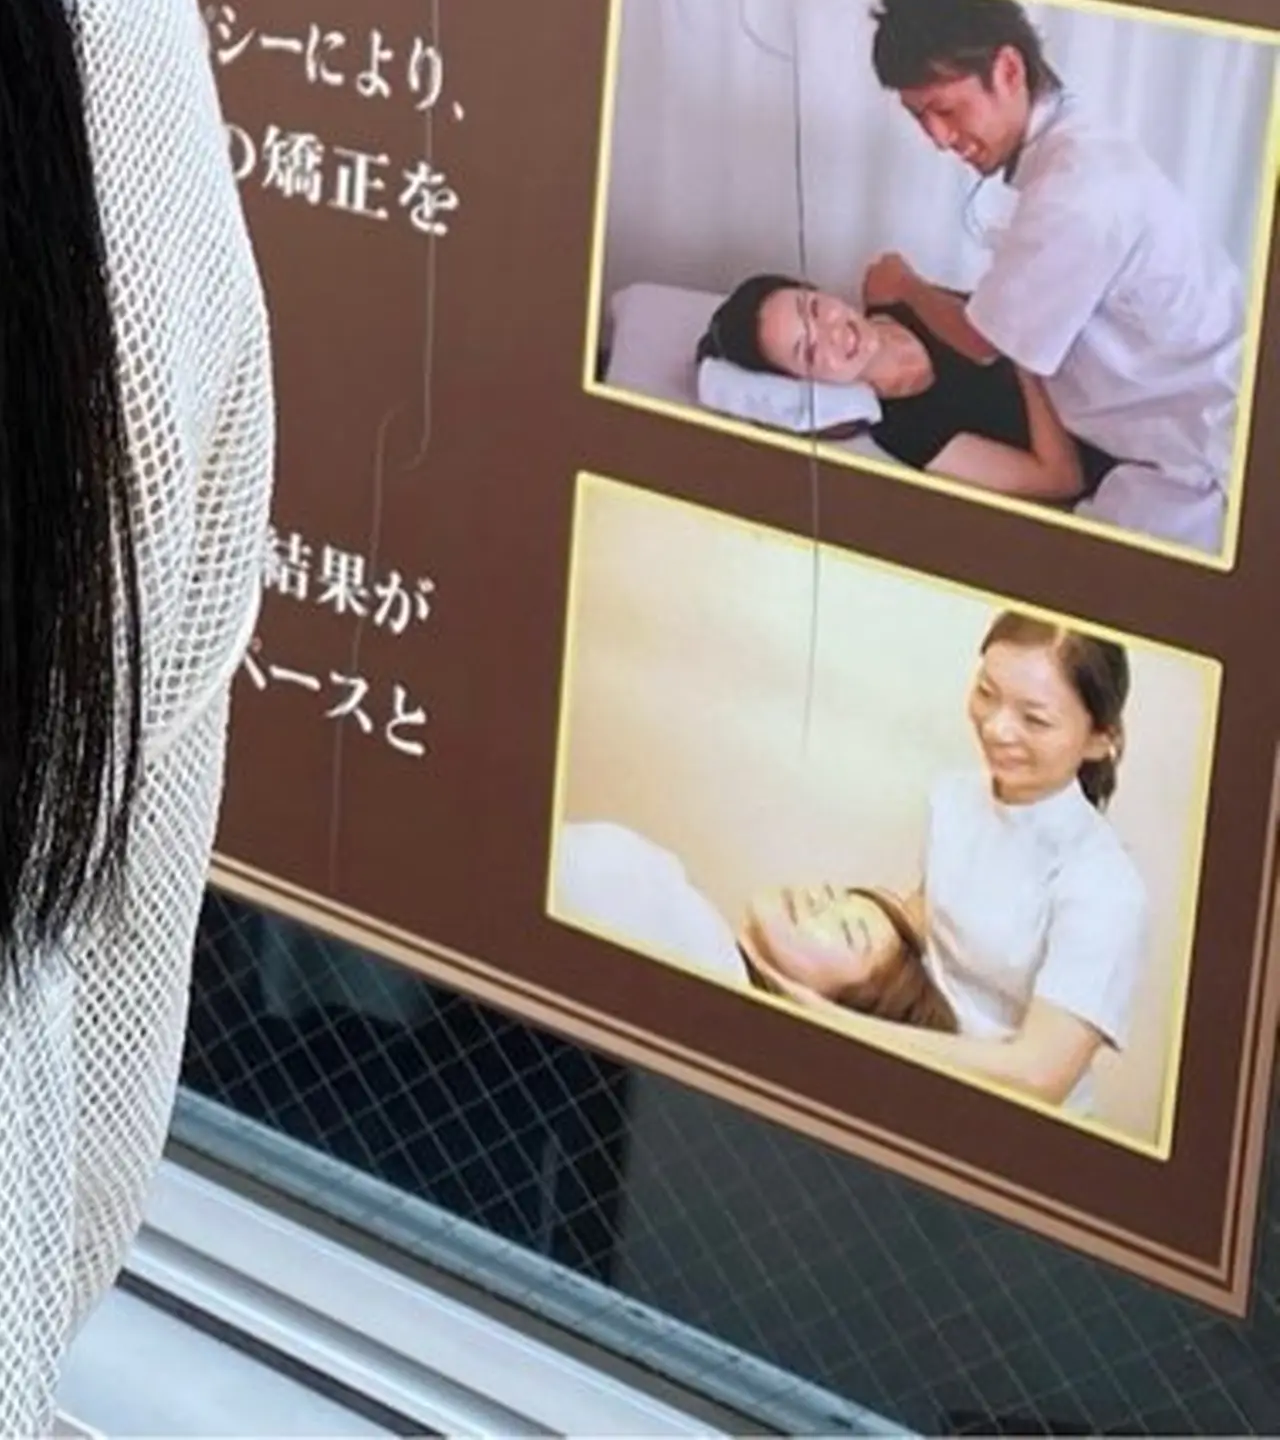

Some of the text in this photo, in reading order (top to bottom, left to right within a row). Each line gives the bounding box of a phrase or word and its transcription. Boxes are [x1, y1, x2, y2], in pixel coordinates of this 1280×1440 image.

[206, 3, 465, 122] シーにより、
